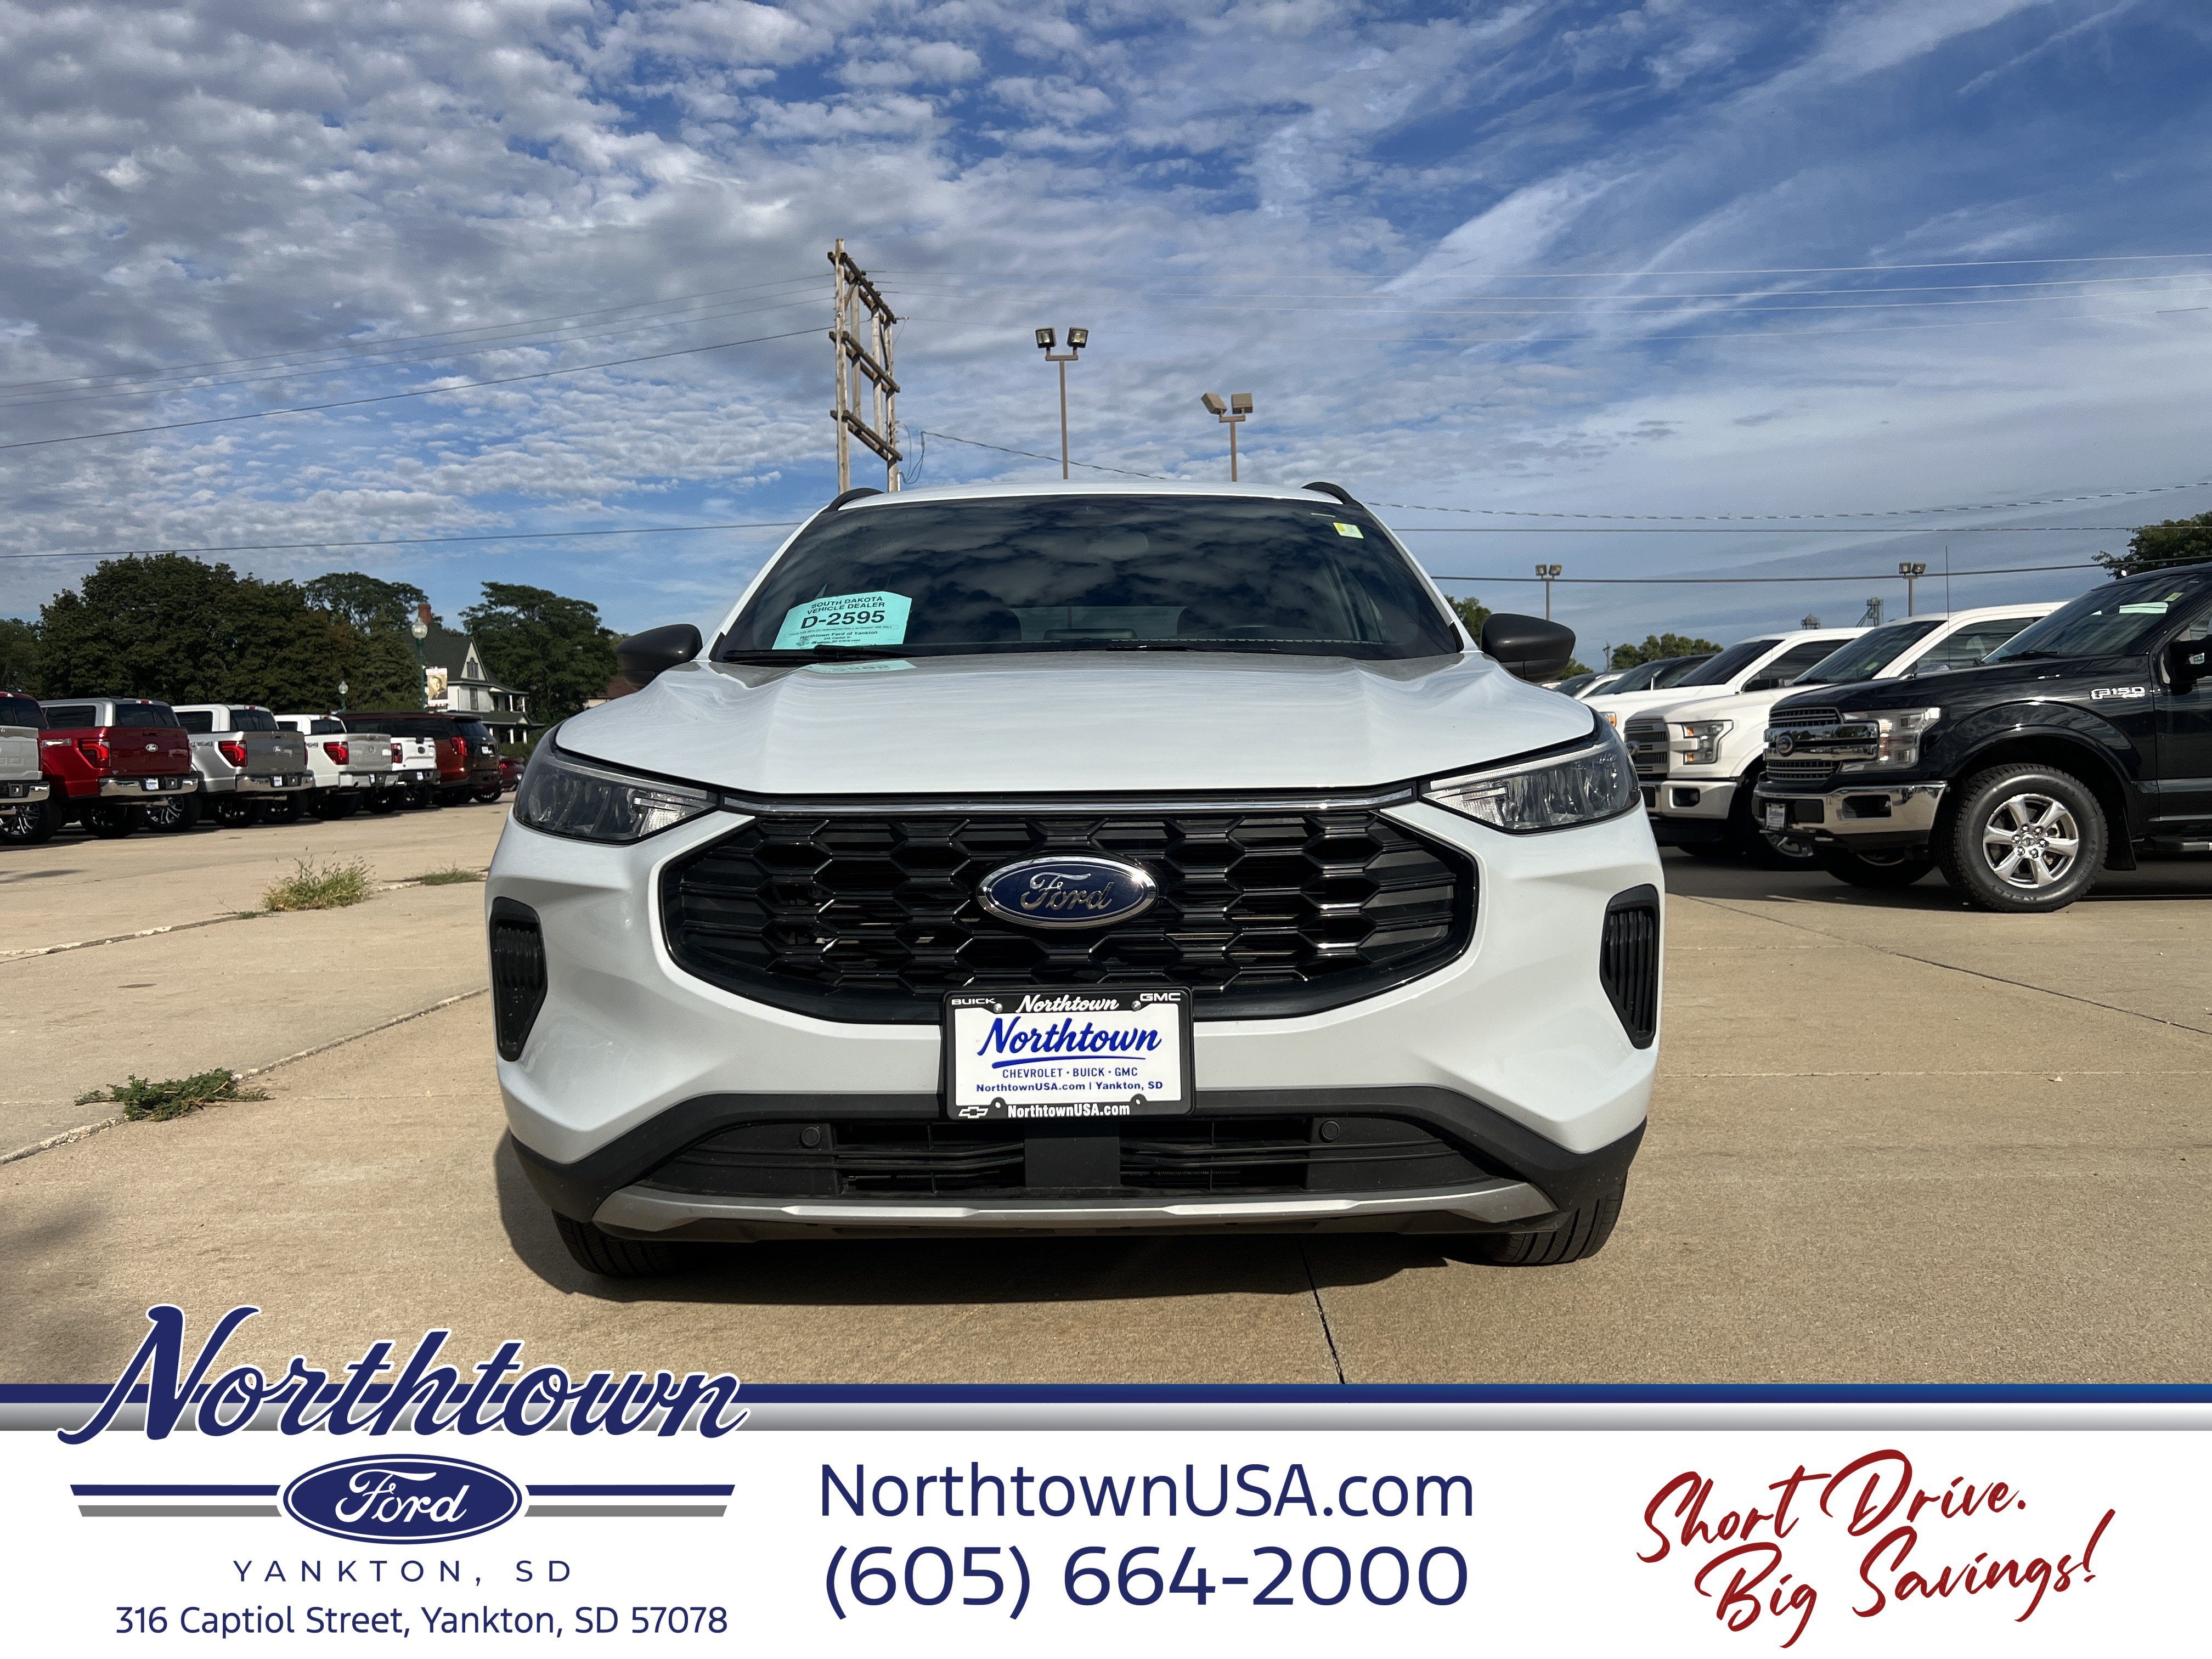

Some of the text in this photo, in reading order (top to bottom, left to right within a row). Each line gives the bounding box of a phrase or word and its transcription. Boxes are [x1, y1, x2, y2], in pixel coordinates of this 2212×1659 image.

[808, 605, 845, 614] VEHICLE
[811, 596, 883, 609] SOUTH DAKOTA
[800, 610, 885, 629] D-2595
[1020, 871, 1114, 911] Ford
[1015, 994, 1119, 1013] Northtown
[1139, 992, 1181, 1001] GMC
[977, 1015, 1162, 1056] Northtown
[1002, 1067, 1138, 1079] CHEVROLET BUICK GMC
[976, 1081, 1163, 1092] NorthtownUSA.com Yankton, SD
[1007, 1103, 1130, 1118] NorthtownUSA.com
